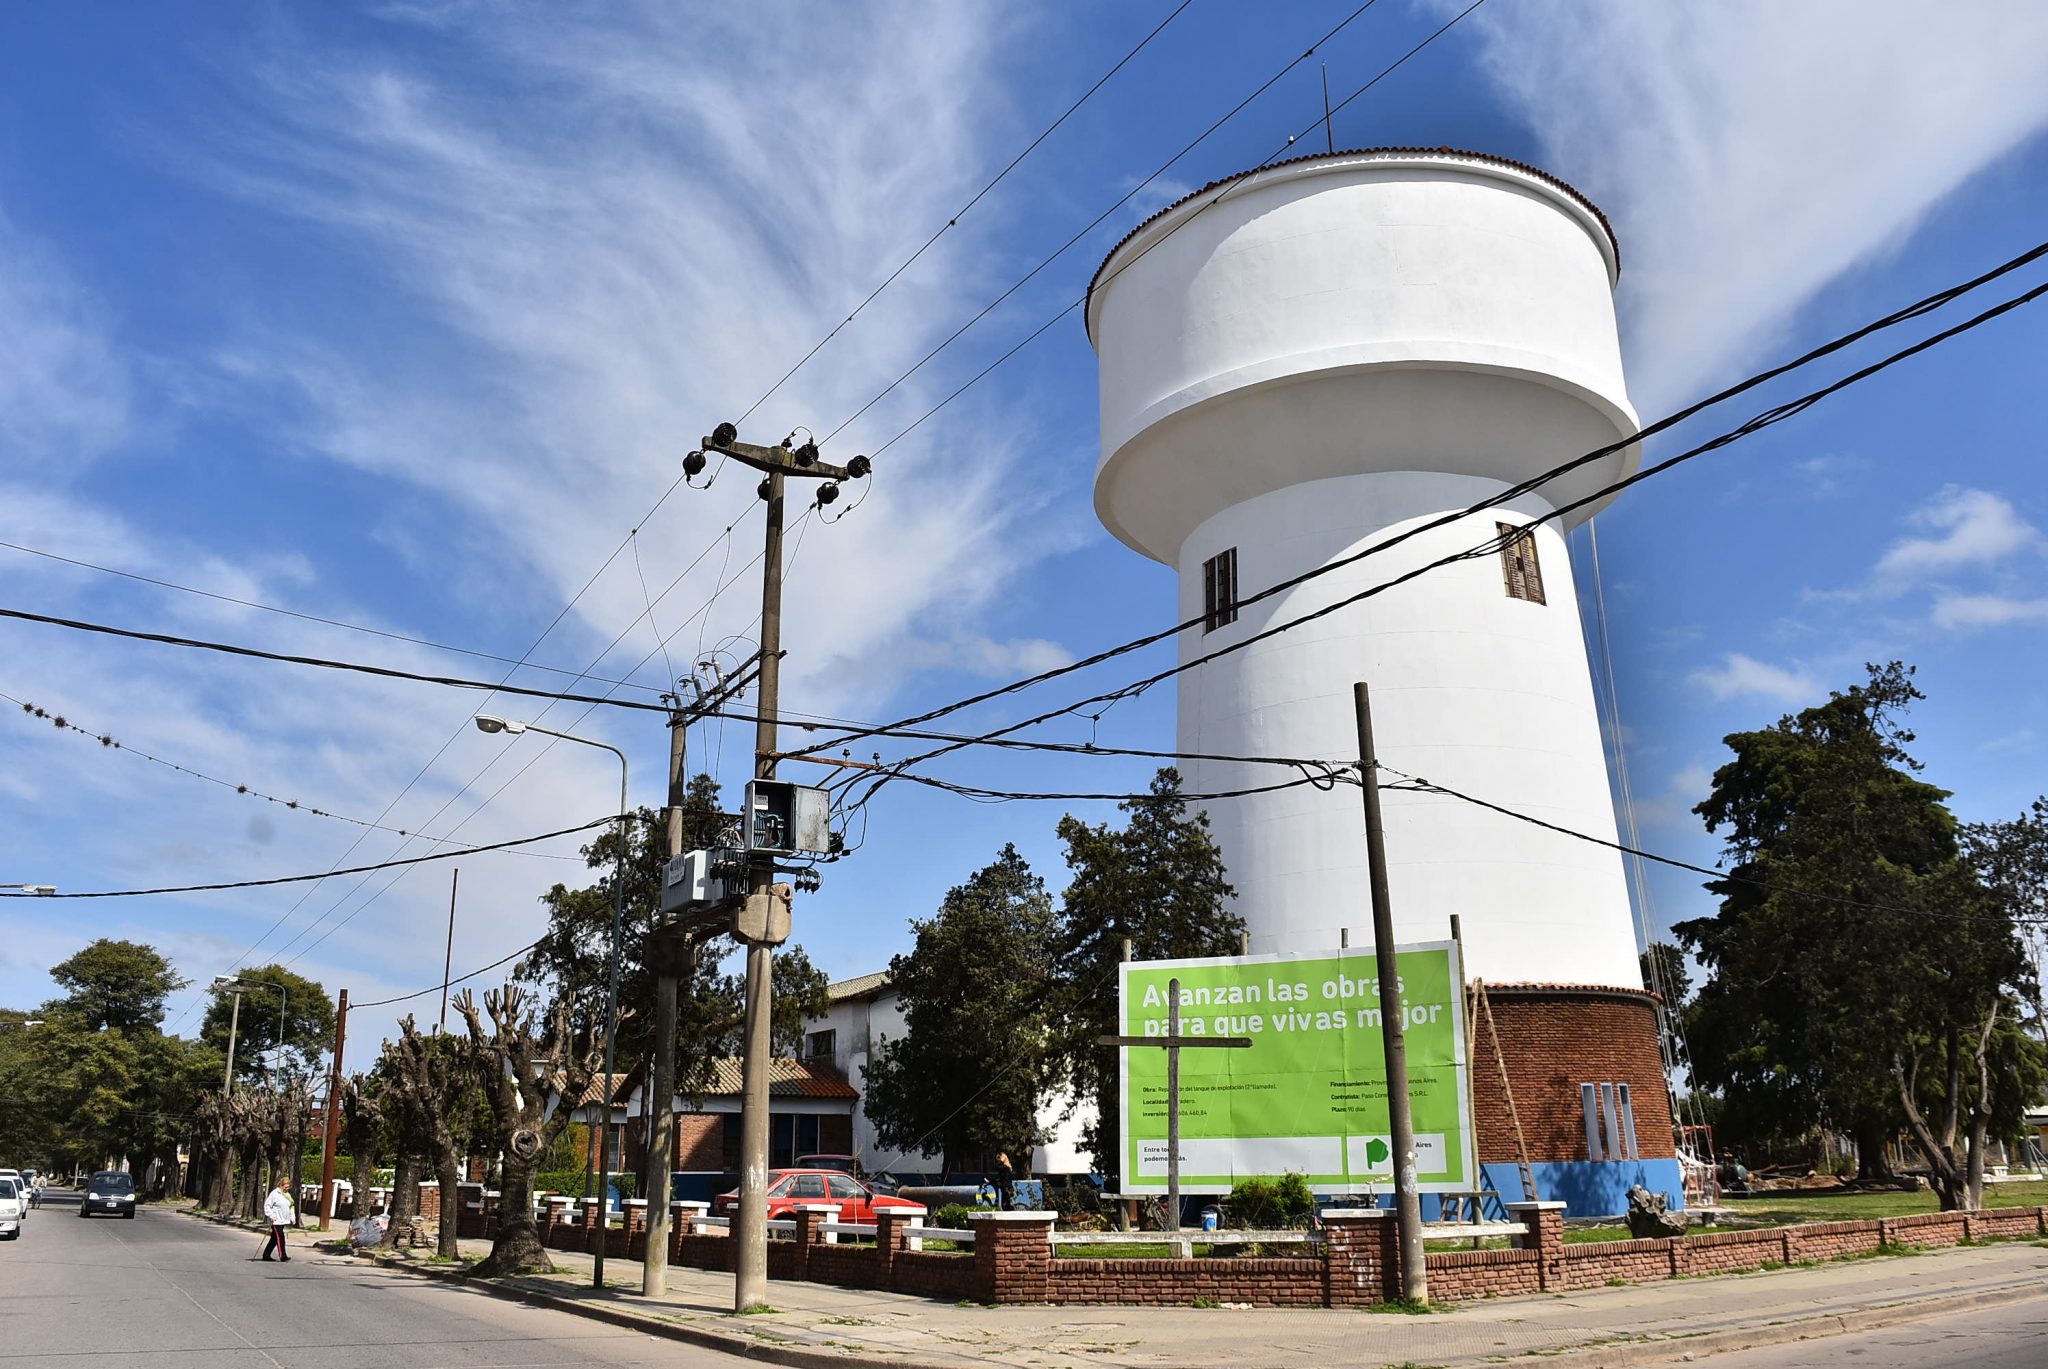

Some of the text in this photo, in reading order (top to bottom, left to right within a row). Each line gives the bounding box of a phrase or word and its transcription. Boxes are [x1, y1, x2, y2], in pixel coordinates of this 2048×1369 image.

[1267, 978, 1308, 1002] las
[1144, 999, 1443, 1038] para que vivas mjor
[1144, 1155, 1168, 1163] podemo
